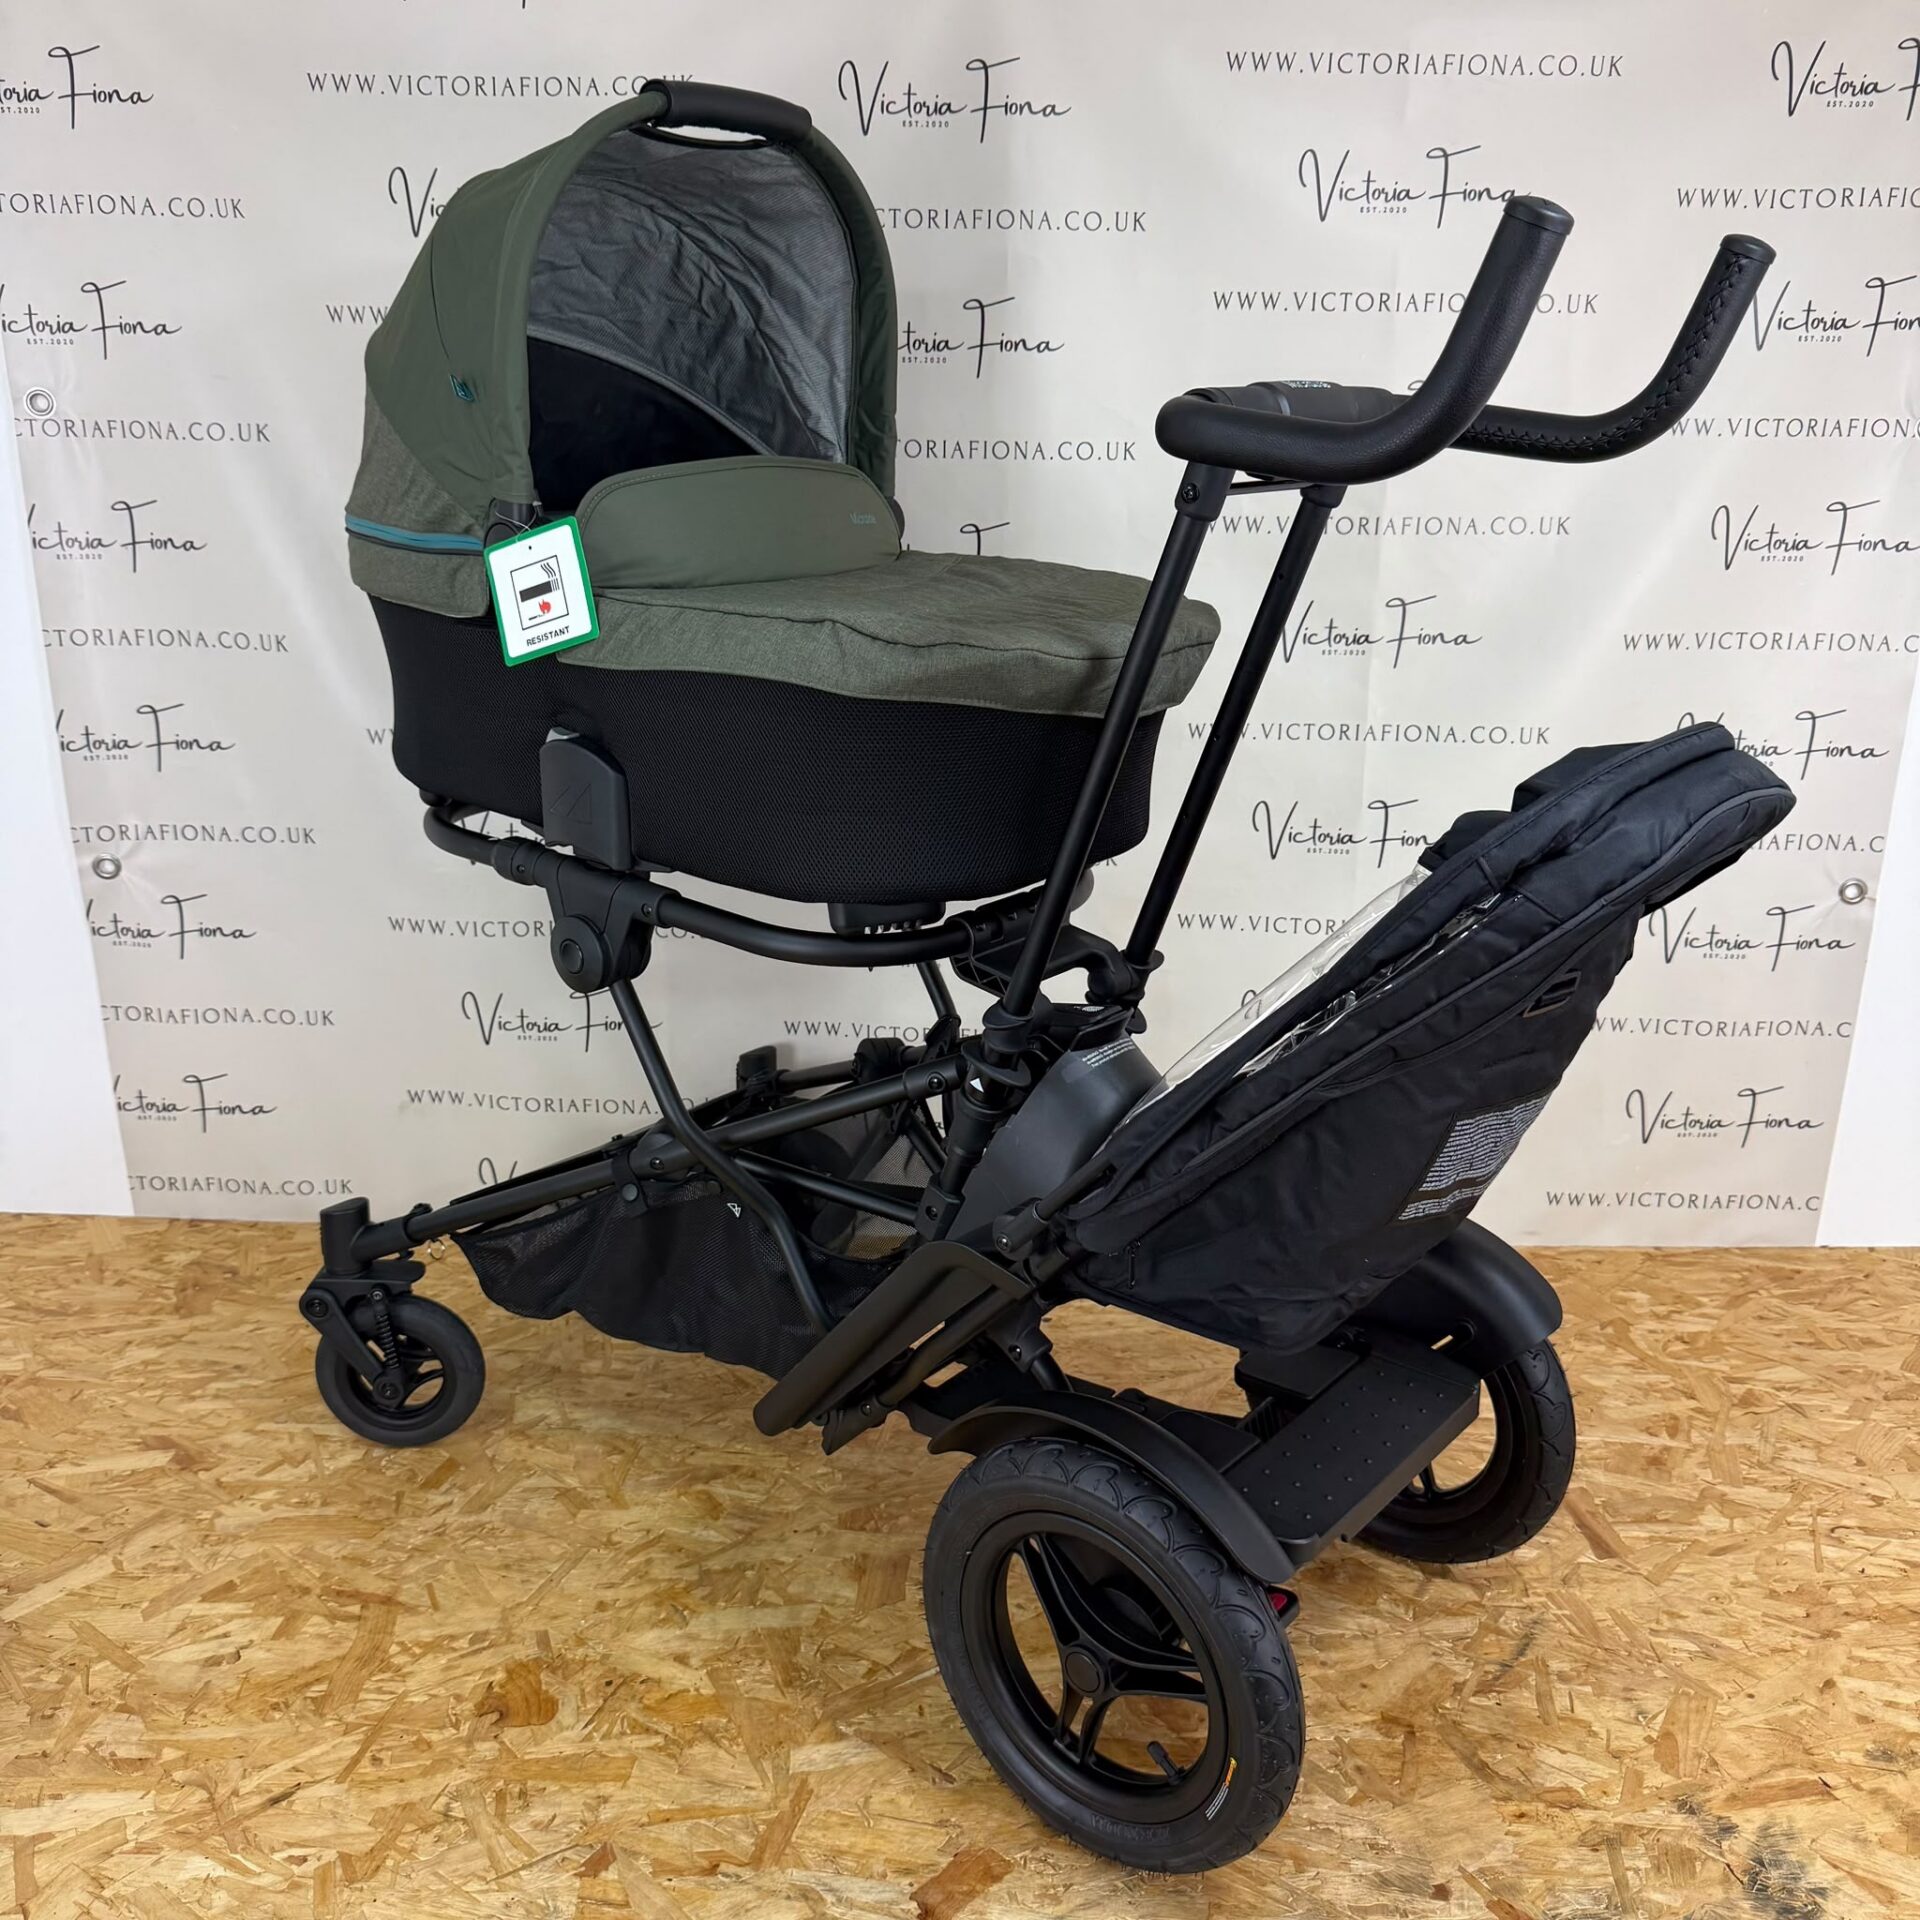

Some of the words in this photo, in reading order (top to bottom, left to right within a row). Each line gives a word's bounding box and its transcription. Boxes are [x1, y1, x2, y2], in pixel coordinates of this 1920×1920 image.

[1226, 51, 1623, 77] WWW.VICTORIAFIONA.CO.UK
[0, 79, 54, 104] oria
[48, 45, 154, 130] Fiona
[1771, 40, 1895, 117] Victoria
[838, 60, 967, 136] Victoria
[966, 57, 1071, 144] Fiona
[1827, 100, 1874, 108] EST.2020
[903, 120, 949, 128] EST.2020
[1299, 149, 1426, 222] Victoria
[1678, 187, 1920, 209] WWW.VICTORIAFI
[0, 193, 245, 218] TORIAFIONA.CO.UK
[876, 208, 1146, 232] TORIAFIONA.CO.UK
[1213, 291, 1598, 313] WWW.VICTORIAFIOO.UK
[0, 284, 88, 336] ictoria
[81, 280, 182, 360] Fiona
[1862, 275, 1920, 357] Fion
[898, 321, 966, 352] toria
[963, 297, 1064, 379] Fiona
[14, 417, 270, 442] TORIAFIONA.CO.UK
[1670, 418, 1914, 438] WW.VICTORIAFION
[897, 439, 1136, 461] ORIAFIONA.CO.UK
[111, 500, 207, 573] Fiona
[1208, 516, 1570, 535] WW.VORIAFIONA.CO.UK
[1711, 505, 1823, 571] Victoria
[1825, 500, 1920, 576] Fiona
[42, 629, 288, 652] TORIAFIONA.CO.UK
[526, 626, 570, 646] RESISTANT
[1385, 595, 1482, 669] Fiona
[1624, 632, 1919, 653] WWW.VICTORIAFIONA.C
[136, 703, 235, 772] Fiona
[1188, 723, 1550, 744] W.VICTORIAFIONA.CO.UK
[1794, 709, 1890, 780] Fiona
[70, 824, 315, 844] TORIAFIONA.CO.UK
[1252, 800, 1367, 860] Victoria
[1368, 800, 1433, 867] Fion
[160, 894, 256, 960] Fiona
[1649, 907, 1763, 964] Victoria
[1765, 905, 1856, 972] Fiona
[101, 1005, 334, 1026] TORIAFIONA.CO.UK
[461, 991, 572, 1046] Victoria
[182, 1074, 277, 1133] Fiona
[1625, 1089, 1735, 1144] Victoria
[1736, 1086, 1824, 1148] Fiona
[128, 1176, 352, 1195] TORIAFIONA.CO.UK
[1547, 1192, 1820, 1211] WWW.VICTORIAFIONA.C
